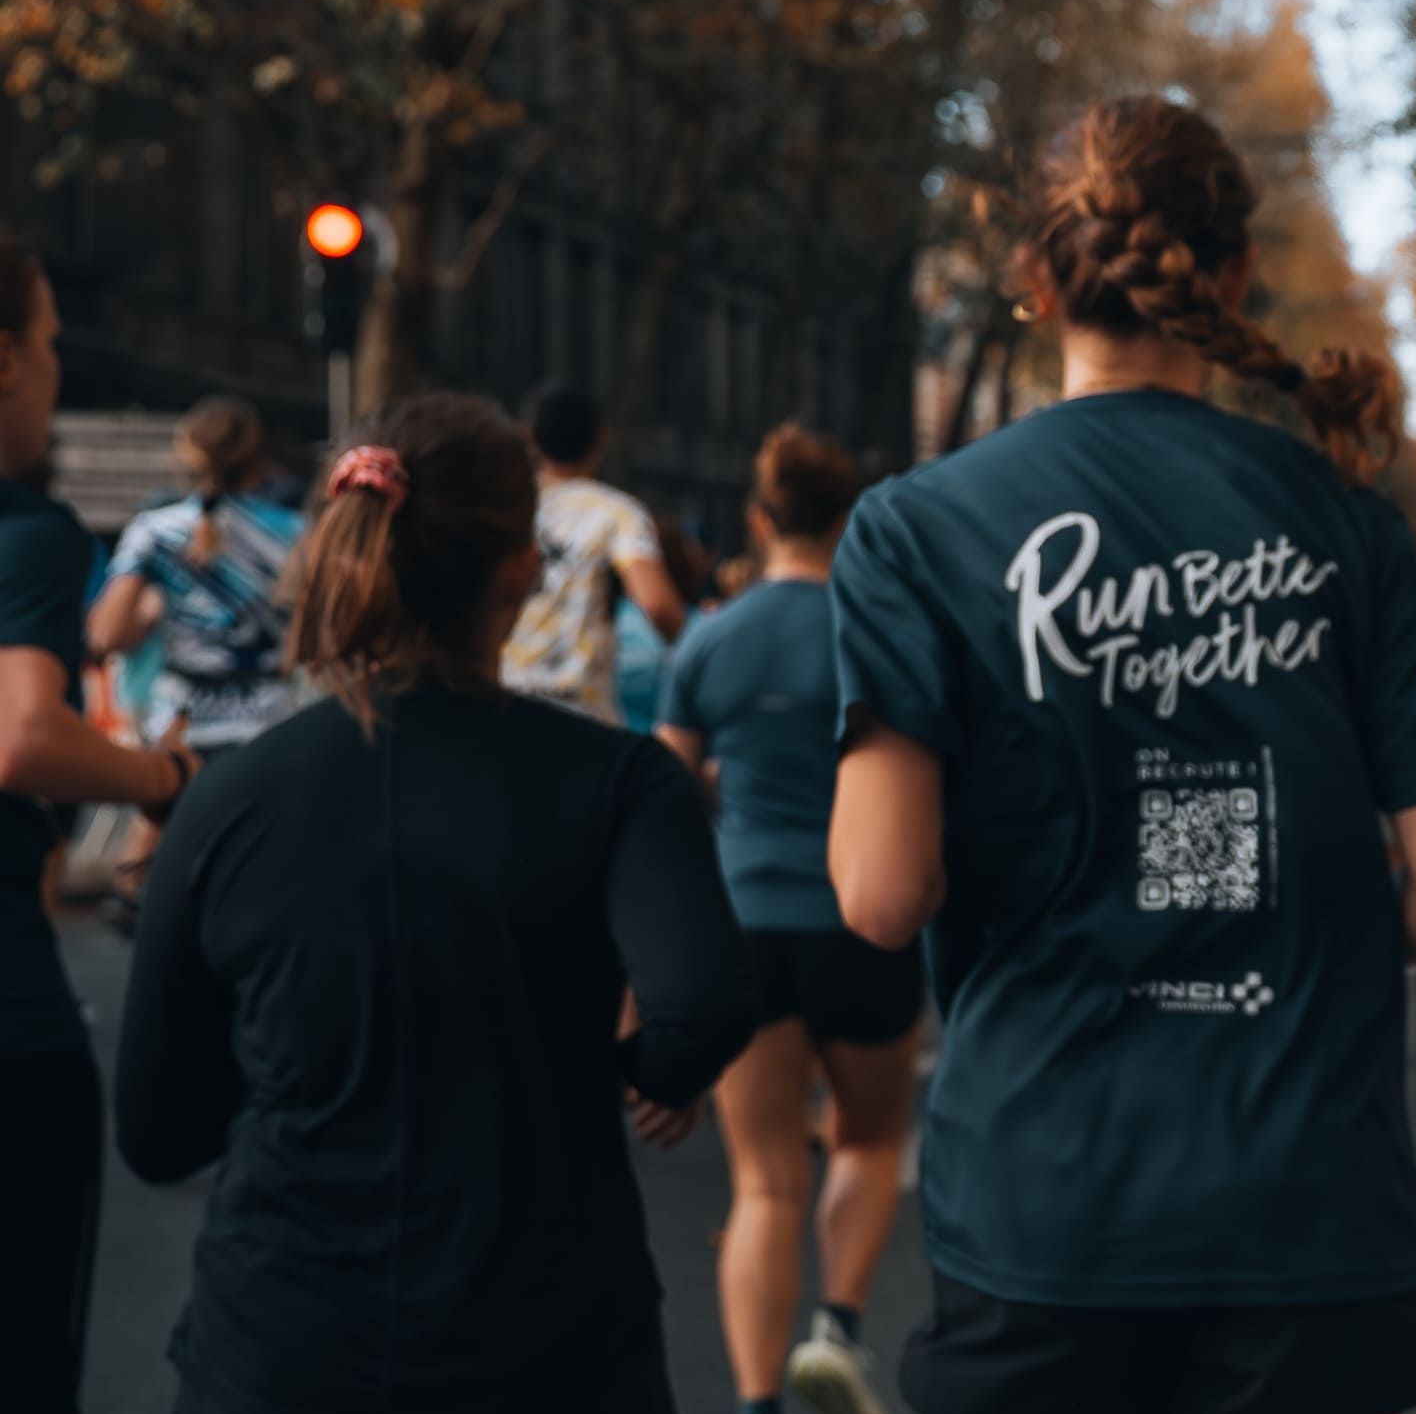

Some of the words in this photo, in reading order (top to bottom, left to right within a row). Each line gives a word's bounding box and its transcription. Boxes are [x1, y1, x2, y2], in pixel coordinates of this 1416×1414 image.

[1005, 512, 1174, 701] Run
[1087, 604, 1331, 719] Together
[1137, 747, 1169, 761] ON
